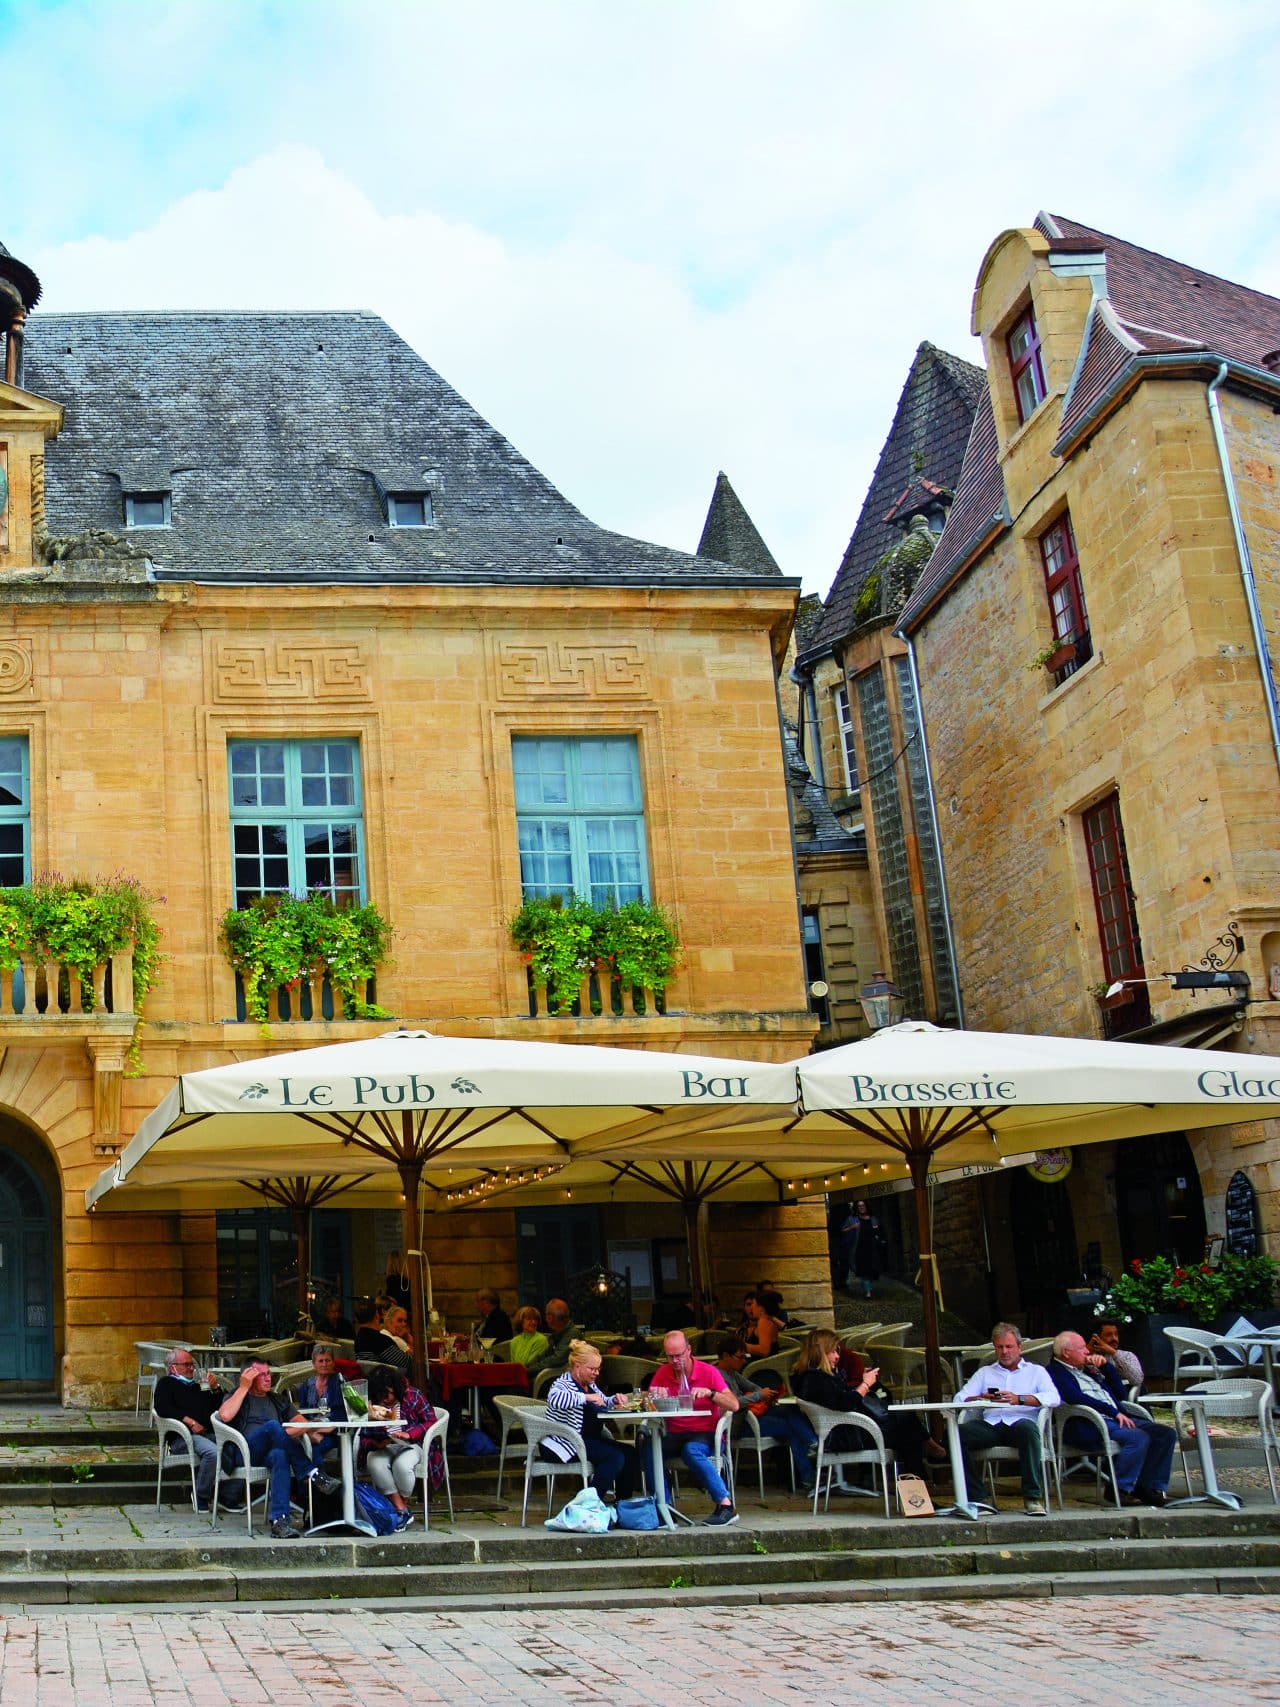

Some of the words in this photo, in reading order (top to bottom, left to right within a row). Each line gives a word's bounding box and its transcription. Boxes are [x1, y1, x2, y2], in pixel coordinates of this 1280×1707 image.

[279, 1077, 334, 1106] Le
[351, 1074, 435, 1105] Pub
[679, 1070, 752, 1098] Bar
[849, 1072, 1017, 1103] Brasserie
